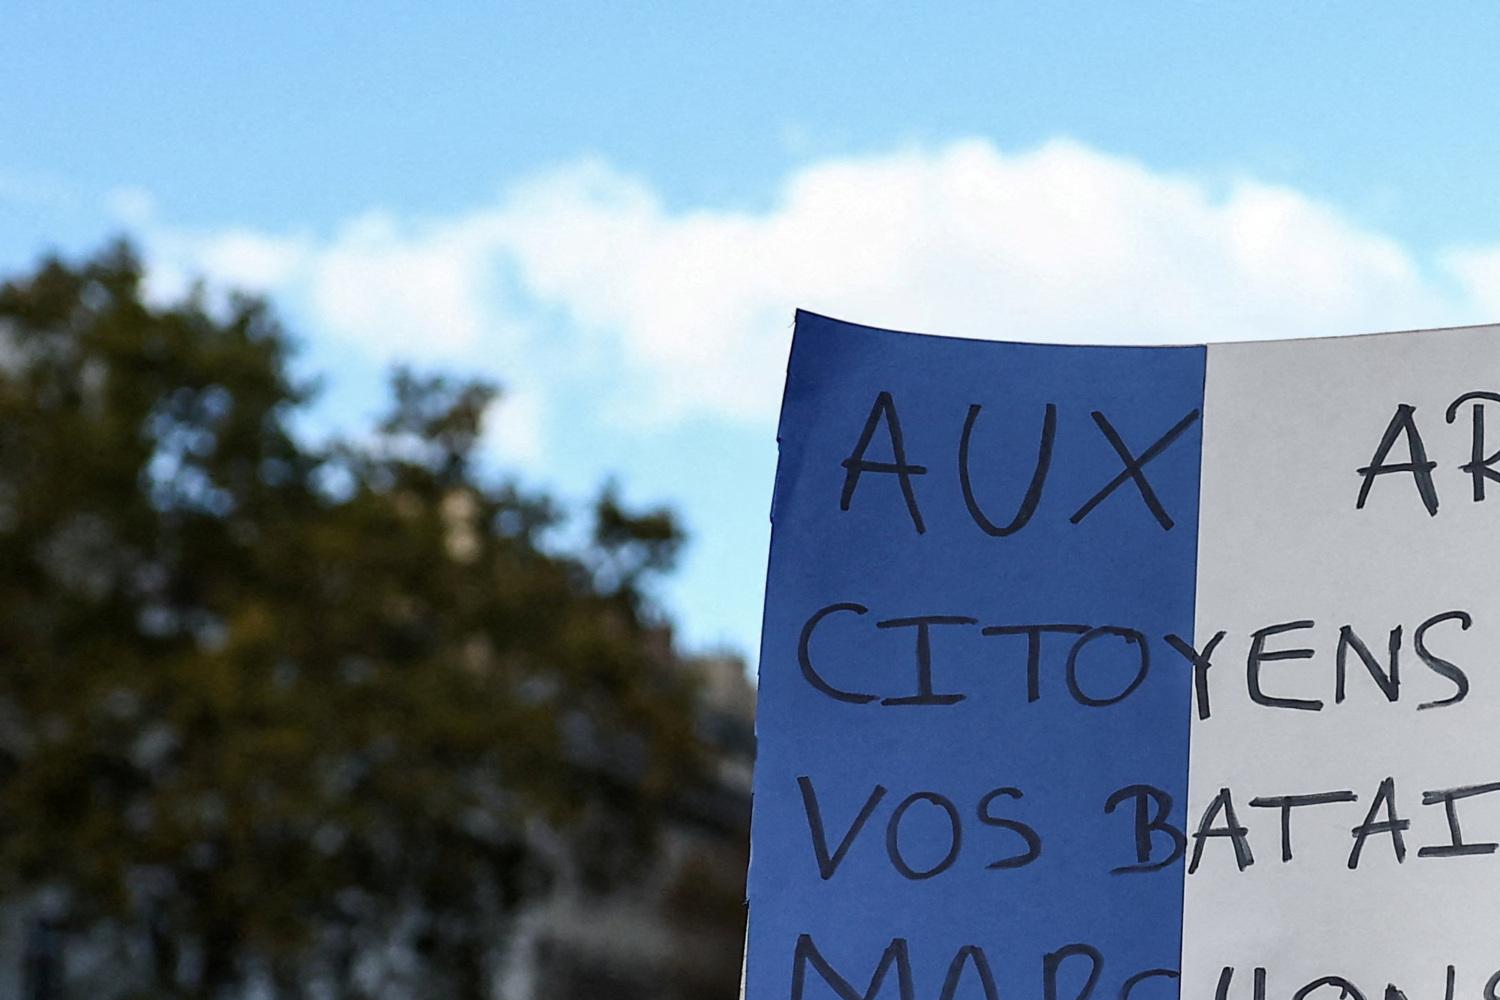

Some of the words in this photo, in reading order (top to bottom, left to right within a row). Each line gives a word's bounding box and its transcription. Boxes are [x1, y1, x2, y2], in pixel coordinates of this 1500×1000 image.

[840, 390, 1201, 537] AUX
[797, 602, 1473, 721] CITOYENS
[796, 775, 1043, 880] VOS
